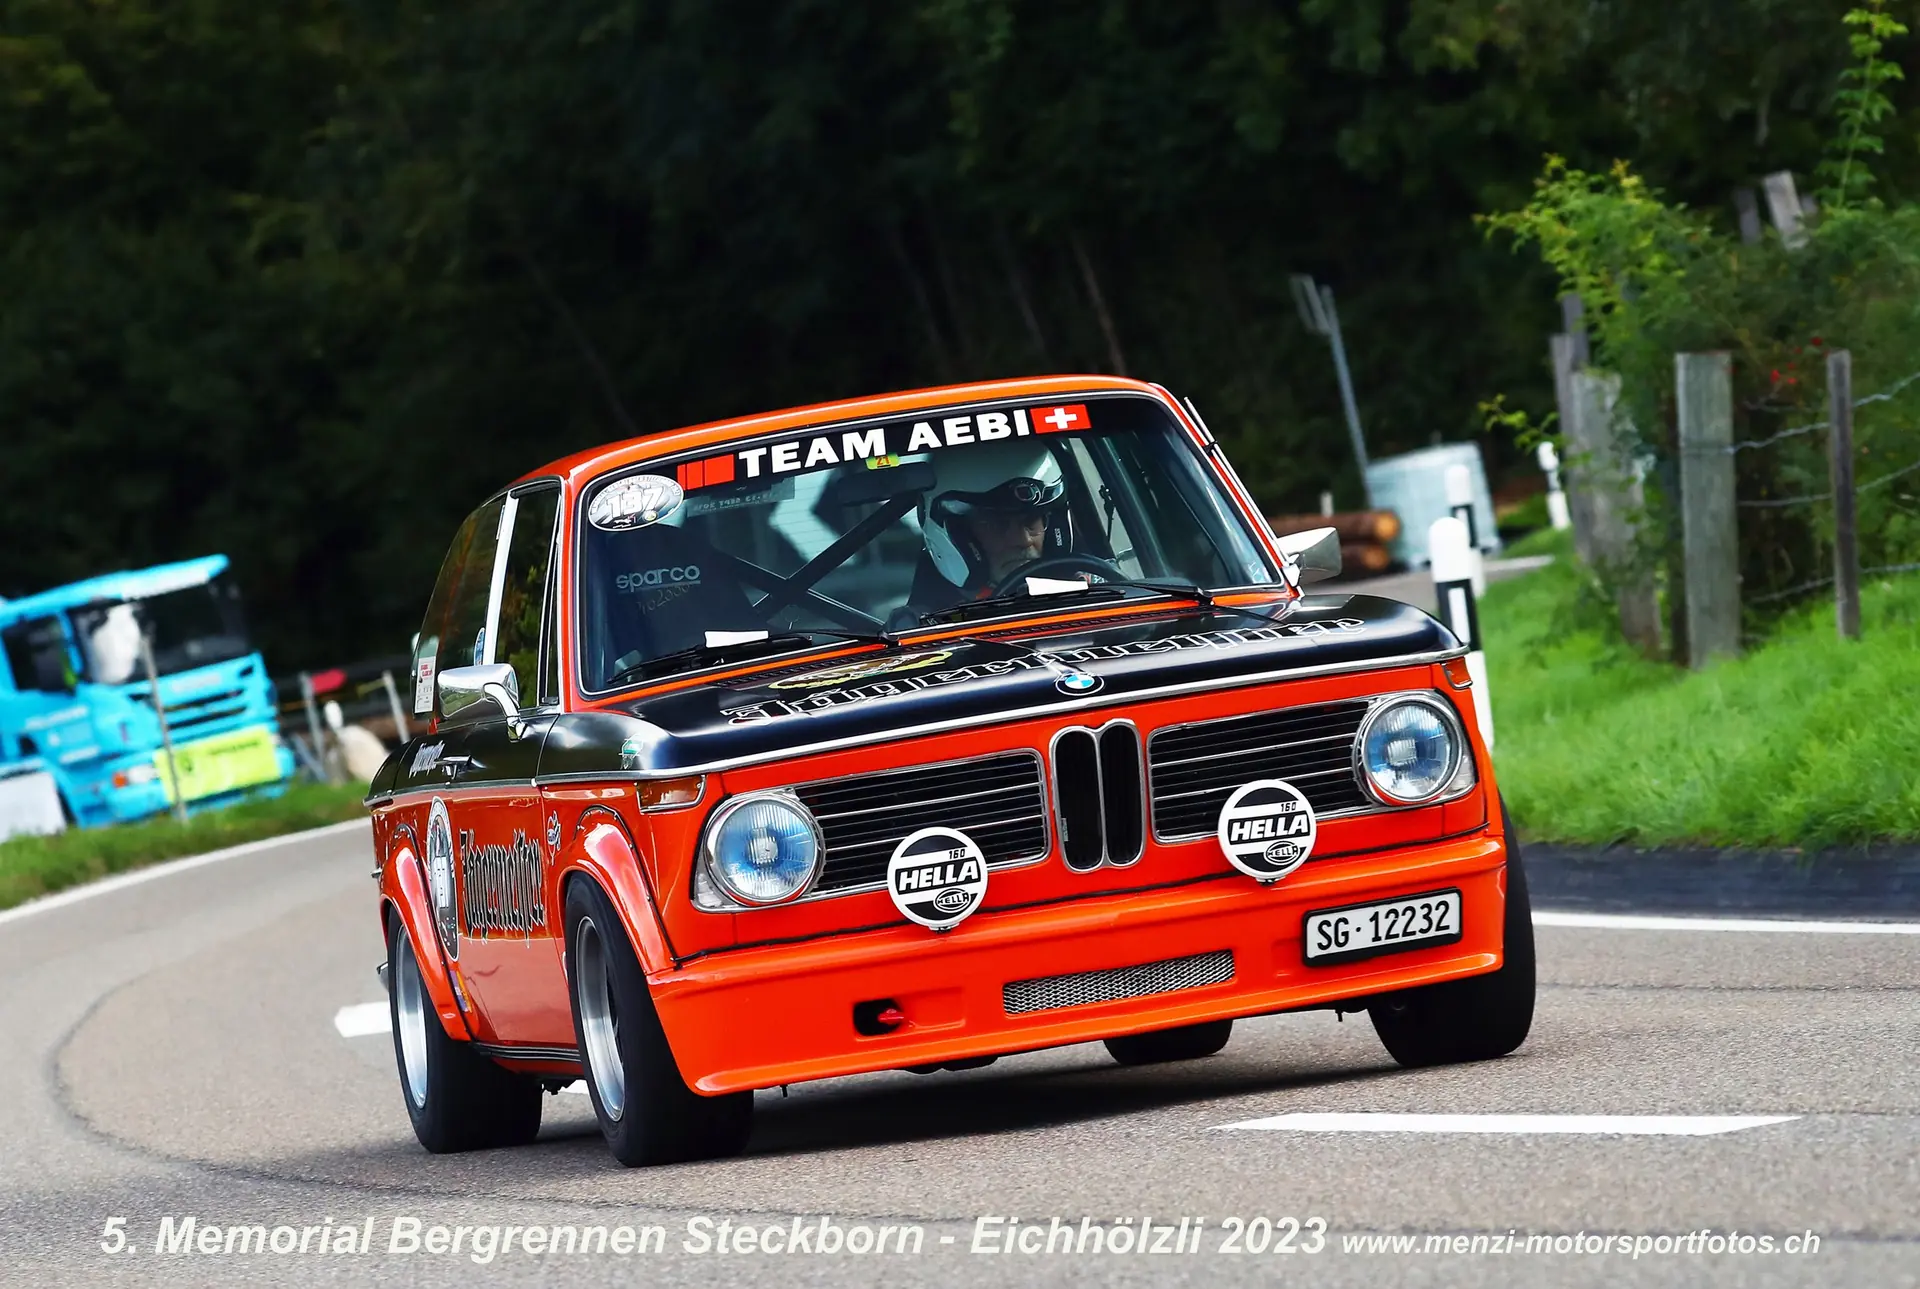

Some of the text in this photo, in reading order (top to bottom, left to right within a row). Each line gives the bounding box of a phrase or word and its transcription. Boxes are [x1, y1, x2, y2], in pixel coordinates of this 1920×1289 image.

[738, 408, 1031, 478] TEAM AEBI
[615, 565, 701, 593] sparco
[1280, 802, 1297, 812] 160
[1230, 814, 1309, 842] HELLA
[948, 848, 966, 859] 160
[1266, 845, 1299, 856] HELLA
[898, 860, 979, 891] HELLA
[937, 891, 970, 905] HELLA
